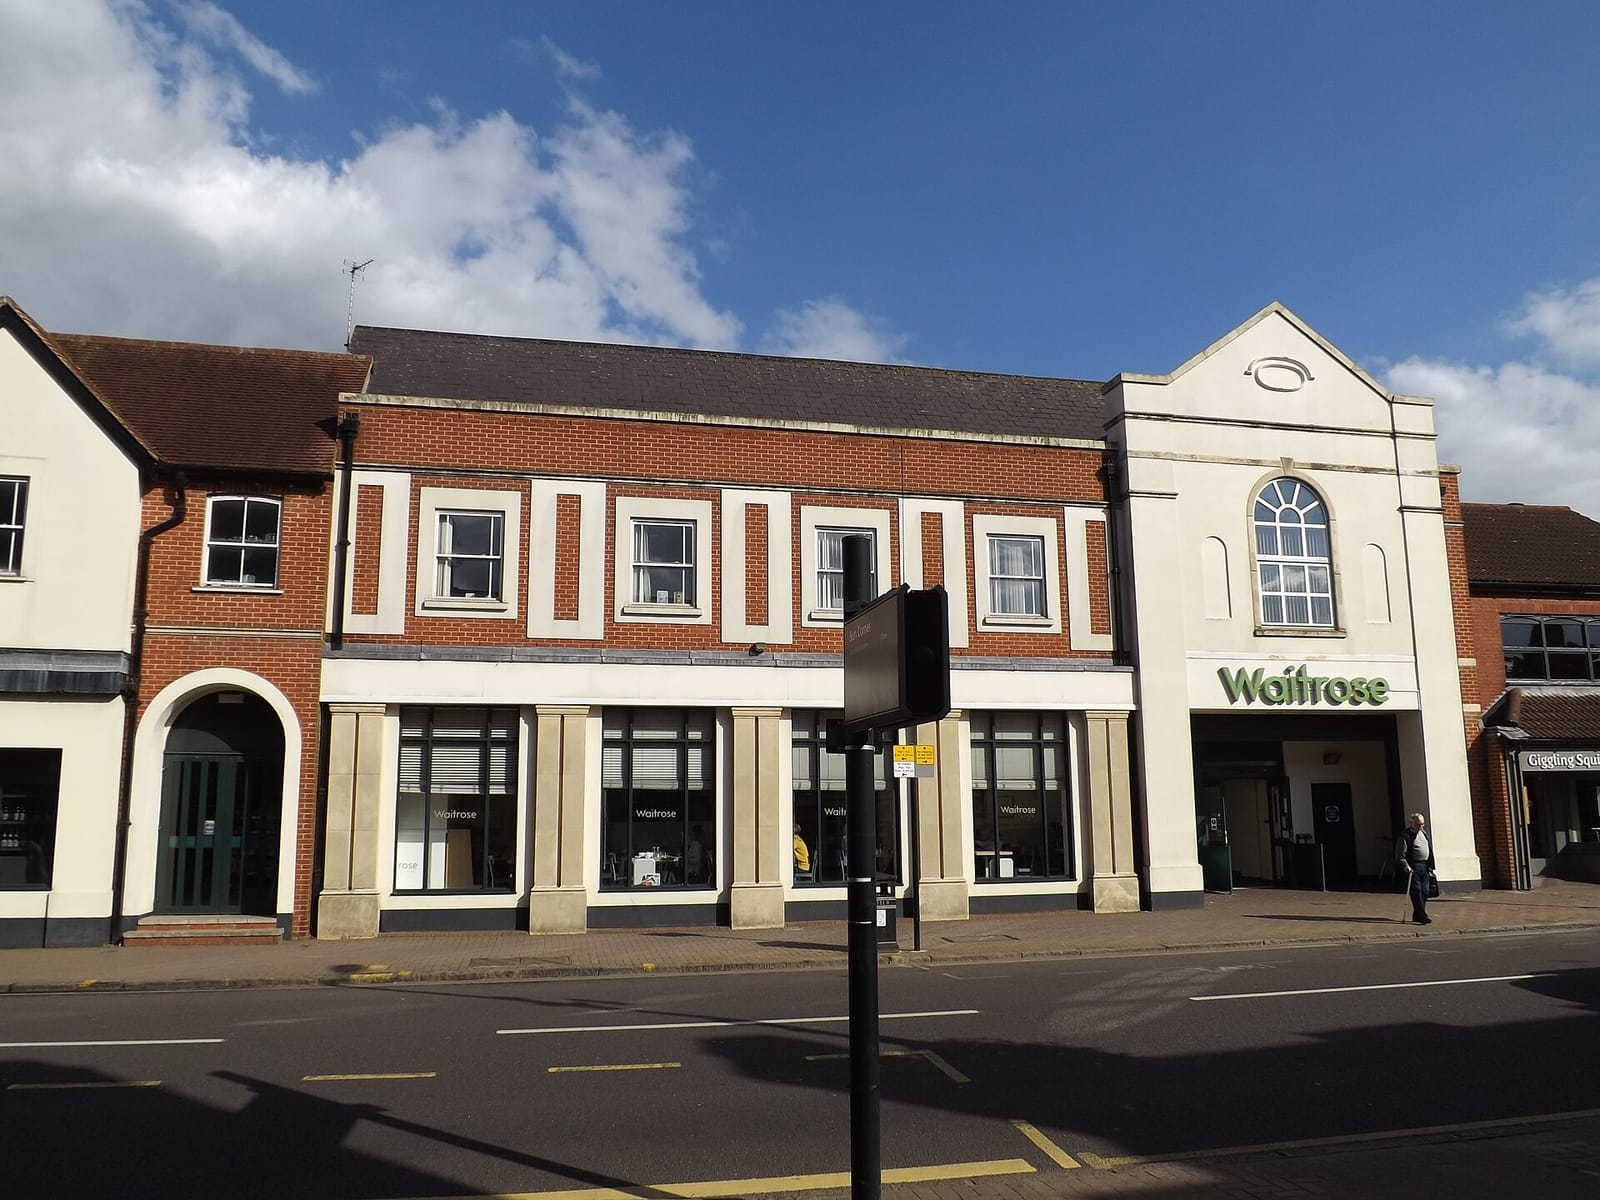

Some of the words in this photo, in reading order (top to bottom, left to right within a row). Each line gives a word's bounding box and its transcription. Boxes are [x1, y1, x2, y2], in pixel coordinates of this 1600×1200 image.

[1216, 663, 1391, 706] Waitrose
[1528, 754, 1574, 769] Giggling
[434, 809, 478, 819] Waitrose
[635, 808, 677, 818] Waitrose
[1000, 804, 1036, 814] Waitrose
